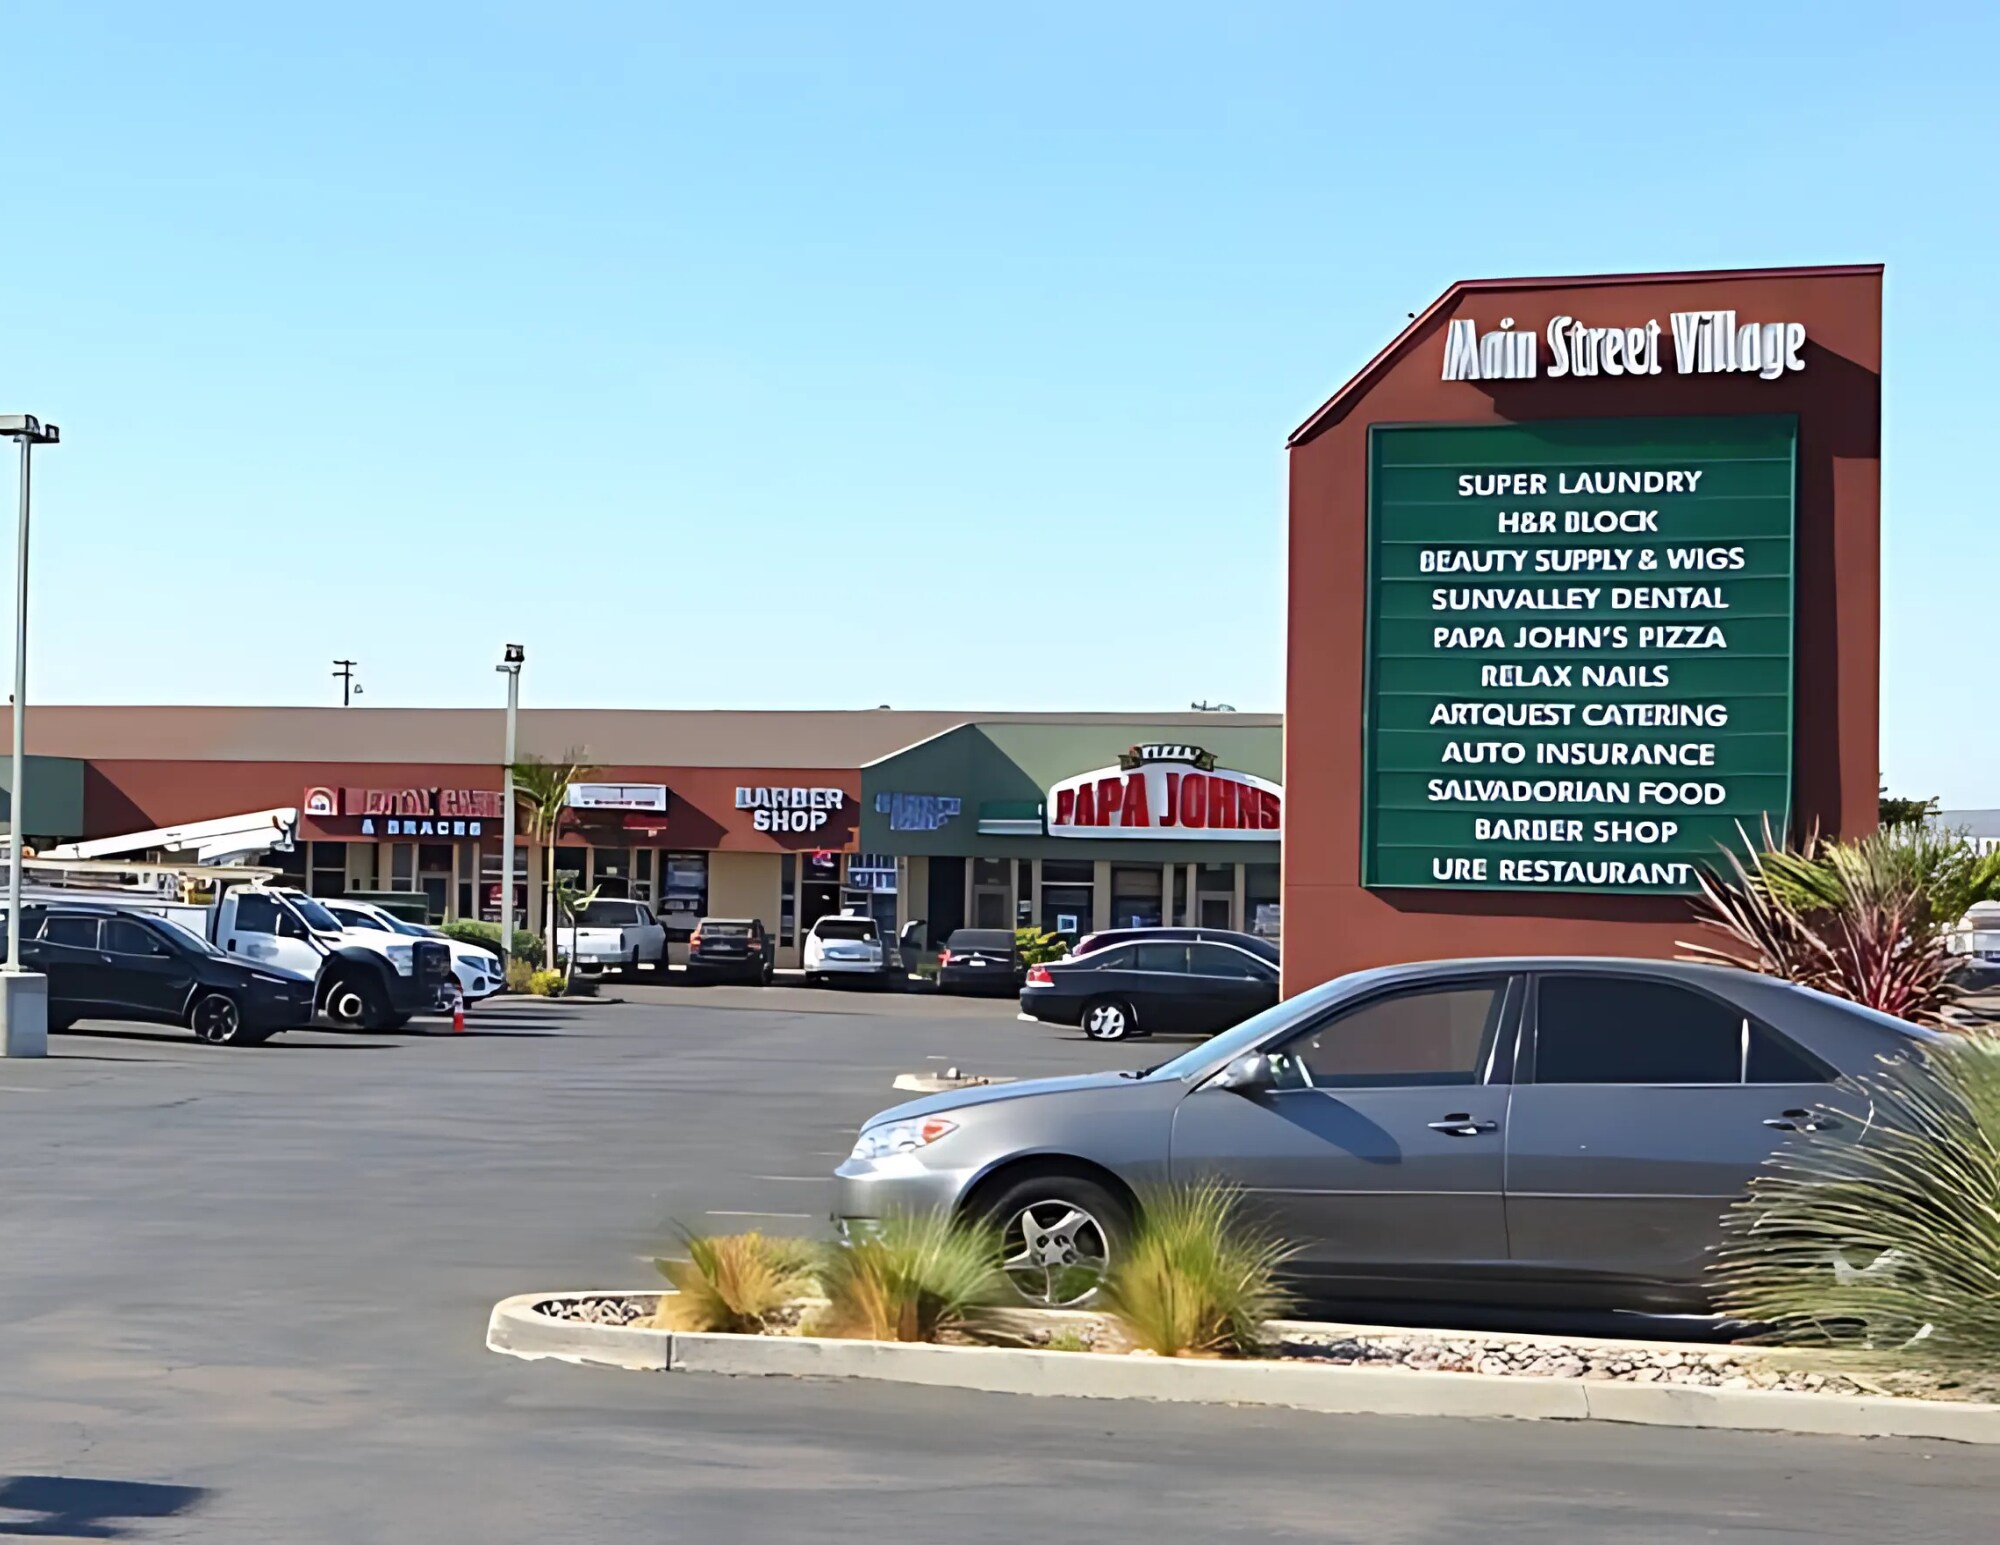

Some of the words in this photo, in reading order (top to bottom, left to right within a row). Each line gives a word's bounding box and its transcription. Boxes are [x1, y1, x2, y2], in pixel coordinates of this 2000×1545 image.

[1441, 317, 1537, 381] Main
[1547, 315, 1662, 378] Street
[1670, 310, 1806, 380] Village
[1458, 473, 1547, 497] SUPER
[1558, 470, 1703, 495] LAUNDRY
[1498, 511, 1557, 534] H&R
[1564, 510, 1658, 533] BLOCK
[1419, 549, 1529, 573] BEAUTY
[1534, 548, 1633, 572] SUPPLY
[1637, 548, 1658, 571] &
[1666, 546, 1746, 570] WIGS
[1431, 586, 1601, 611] SUNVALLEY
[1611, 586, 1730, 610] DENTAL
[1433, 626, 1506, 649] PAPA
[1513, 625, 1628, 649] JOHN'S
[1639, 625, 1727, 649] PIZZA
[1481, 664, 1572, 688] RELAX
[1581, 664, 1669, 688] NAILS
[1429, 703, 1576, 727] ARTQUEST
[1582, 703, 1728, 728] CATERING
[1441, 741, 1526, 764] AUTO
[1536, 742, 1716, 767] INSURANCE
[1054, 773, 1150, 826] PAPA
[1427, 778, 1630, 803] SALVADORIAN
[1638, 781, 1726, 805] FOOD
[753, 809, 828, 833] SHOP
[1475, 818, 1584, 842] BARBER
[1593, 820, 1678, 844] SHOP
[1432, 857, 1487, 881] URE
[1499, 859, 1692, 885] RESTAURANT
